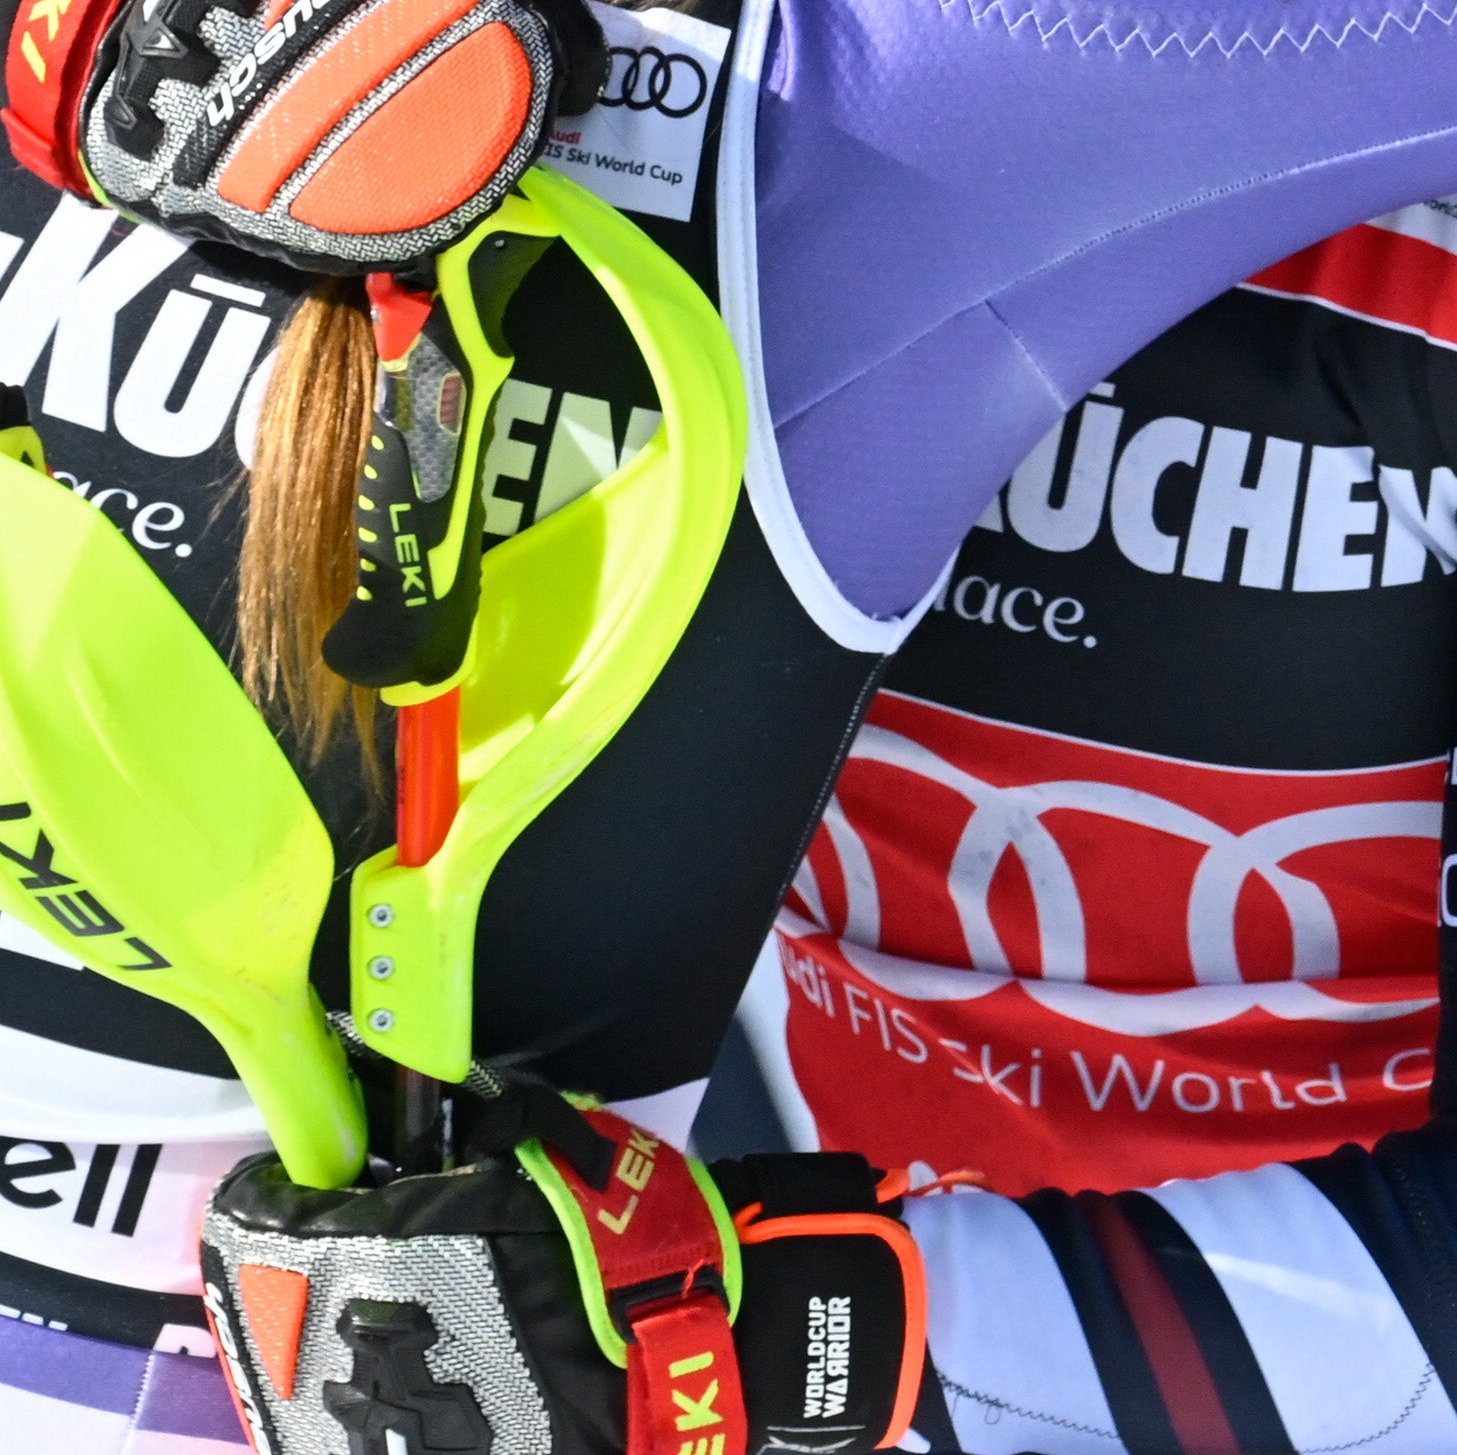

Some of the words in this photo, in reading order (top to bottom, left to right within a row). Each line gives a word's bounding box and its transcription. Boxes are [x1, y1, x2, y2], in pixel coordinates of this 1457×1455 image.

[567, 148, 592, 165] Ski
[595, 153, 645, 177] World
[649, 164, 683, 187] Cup
[389, 502, 428, 608] LEKI
[934, 575, 1098, 649] ace.
[844, 981, 930, 1065] FIS
[1069, 1049, 1348, 1113] World
[803, 1295, 828, 1420] WORLDCUP
